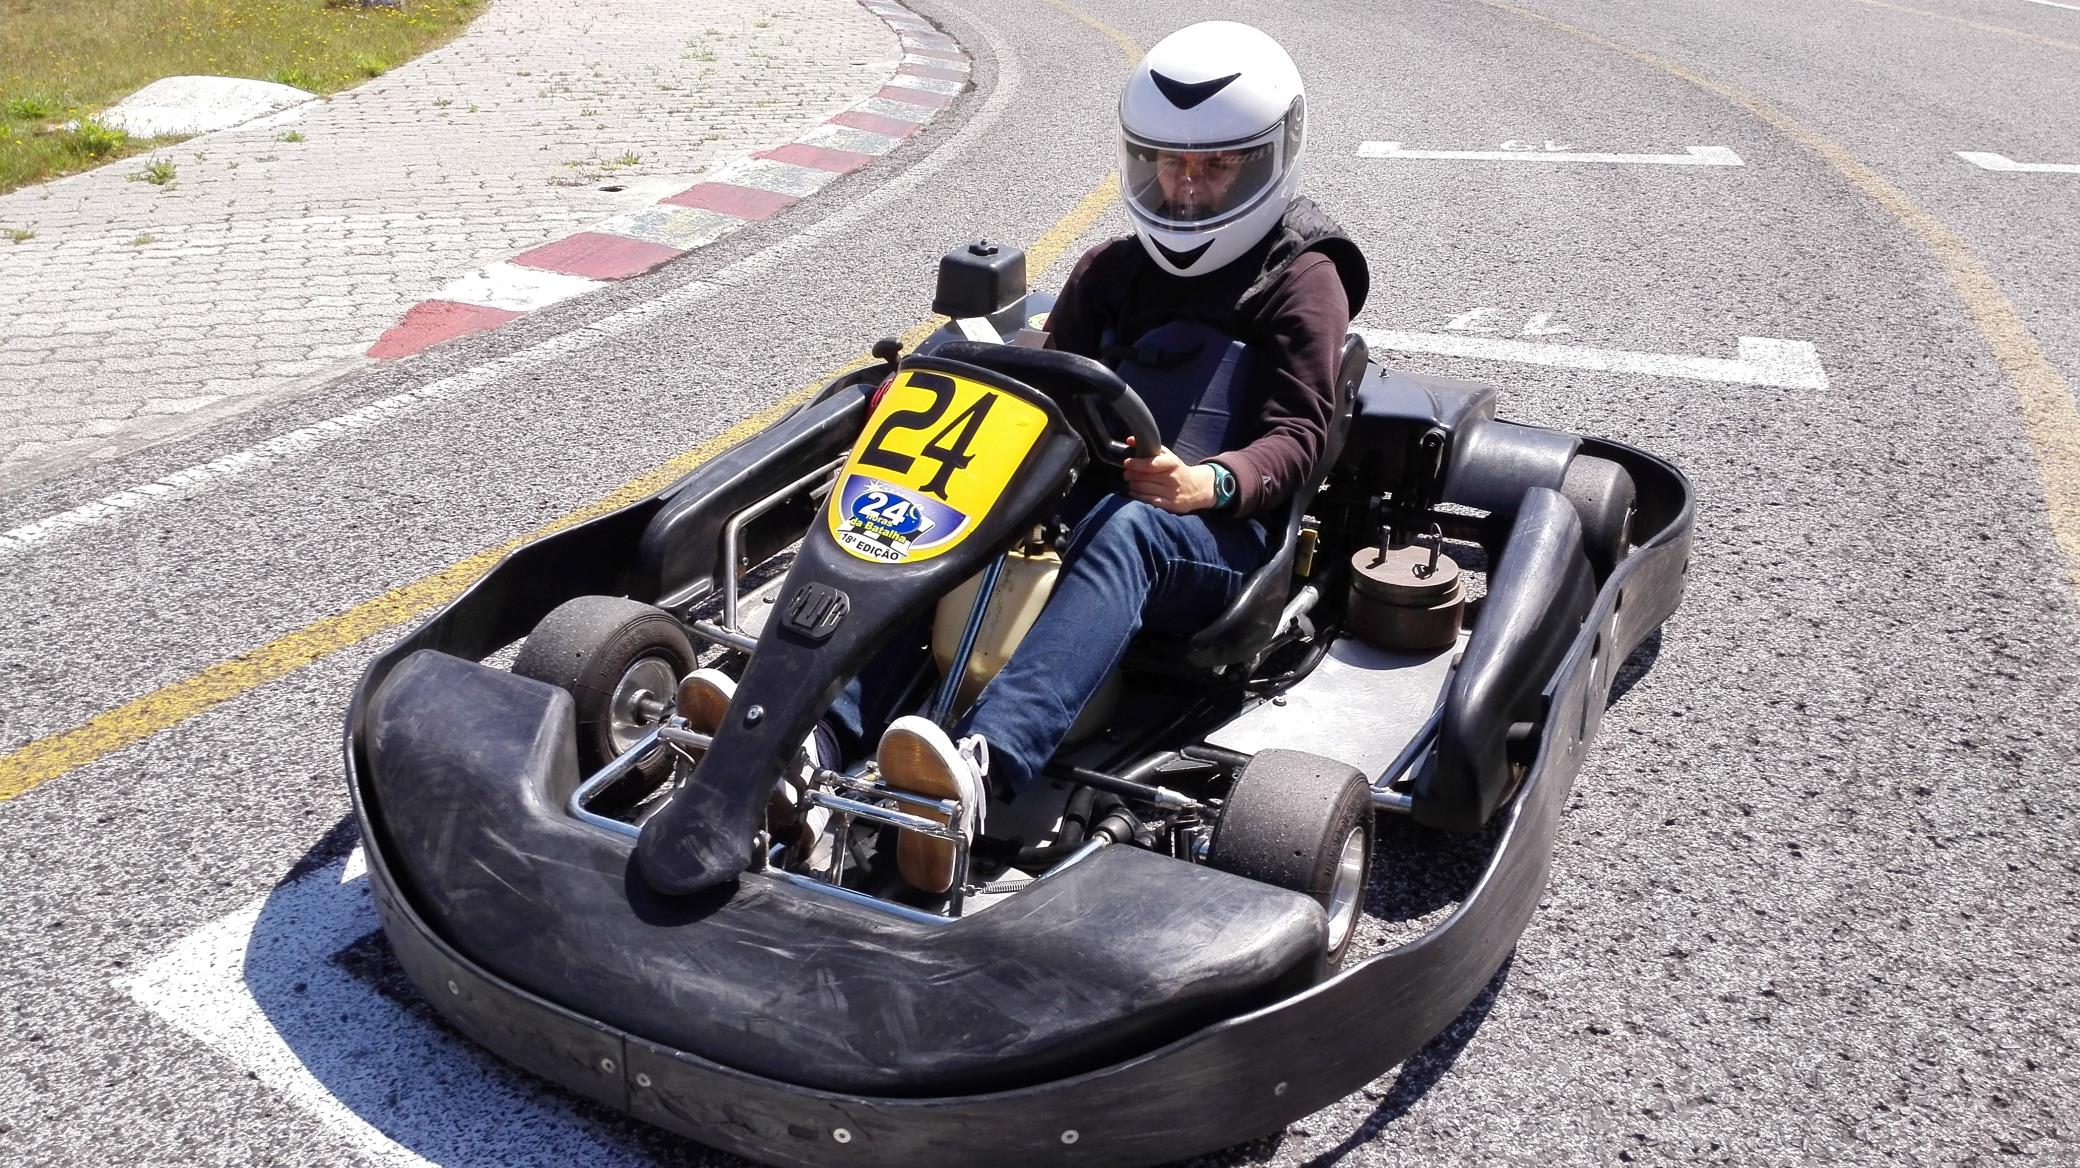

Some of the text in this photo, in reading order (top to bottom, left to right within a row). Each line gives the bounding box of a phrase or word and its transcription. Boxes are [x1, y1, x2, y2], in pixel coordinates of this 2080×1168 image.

[857, 371, 999, 501] 24
[859, 491, 911, 526] 24
[850, 517, 908, 544] da Batalha
[856, 540, 899, 561] EDIÇÃO
